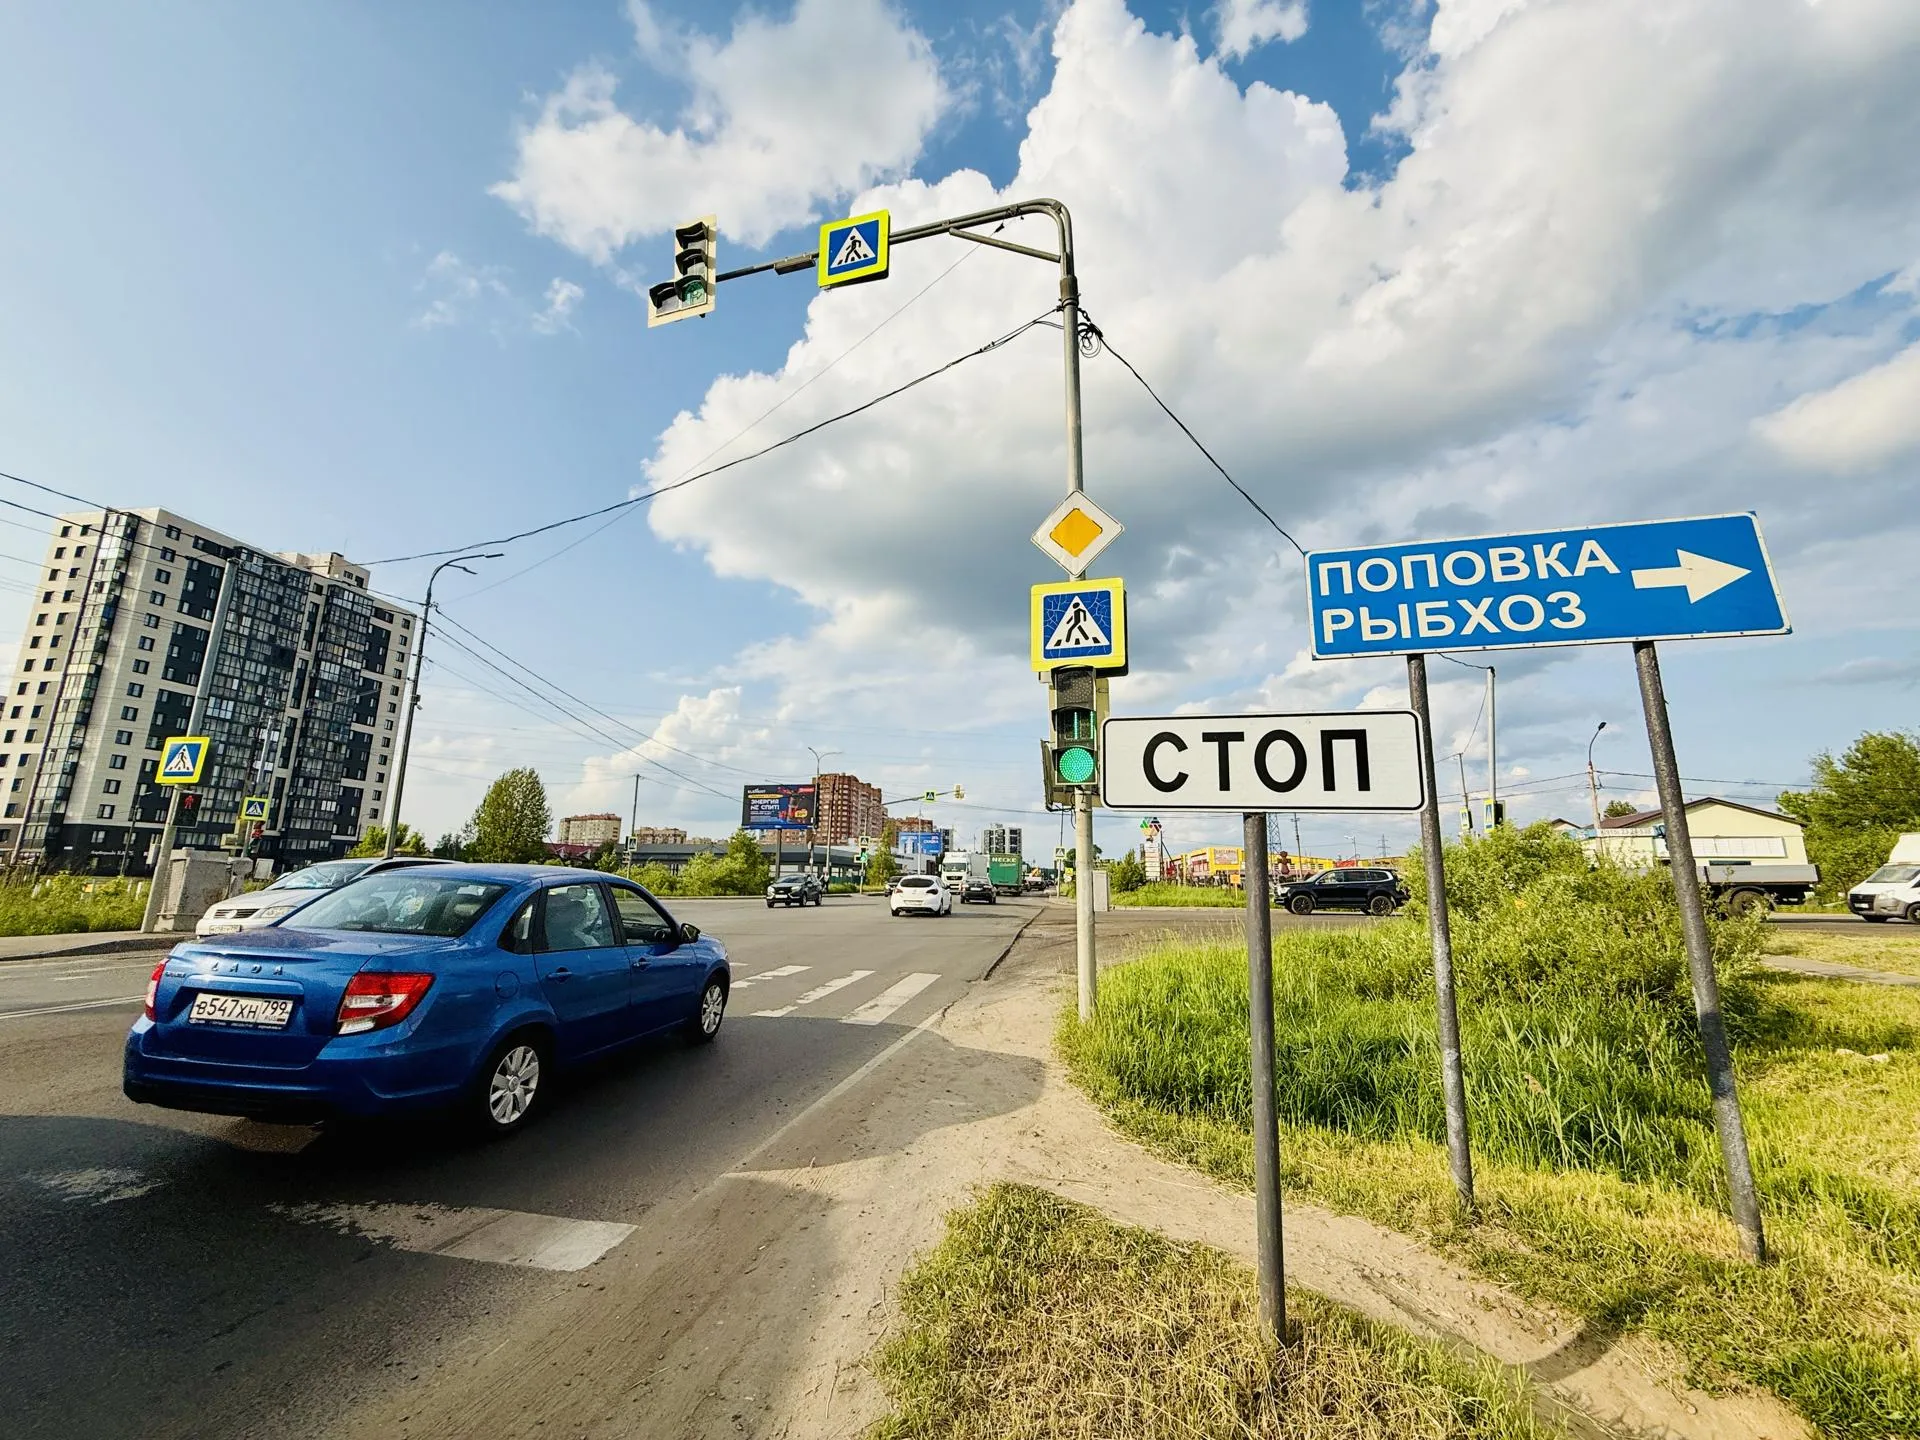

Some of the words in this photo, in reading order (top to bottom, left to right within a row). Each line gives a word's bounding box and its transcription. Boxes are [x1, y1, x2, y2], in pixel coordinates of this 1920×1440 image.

[1318, 540, 1620, 598] ПОПОВКА
[1322, 590, 1587, 644] РЫБХОЗ
[1142, 729, 1371, 794] СТОП
[211, 962, 284, 976] LADA
[262, 1000, 288, 1016] 799
